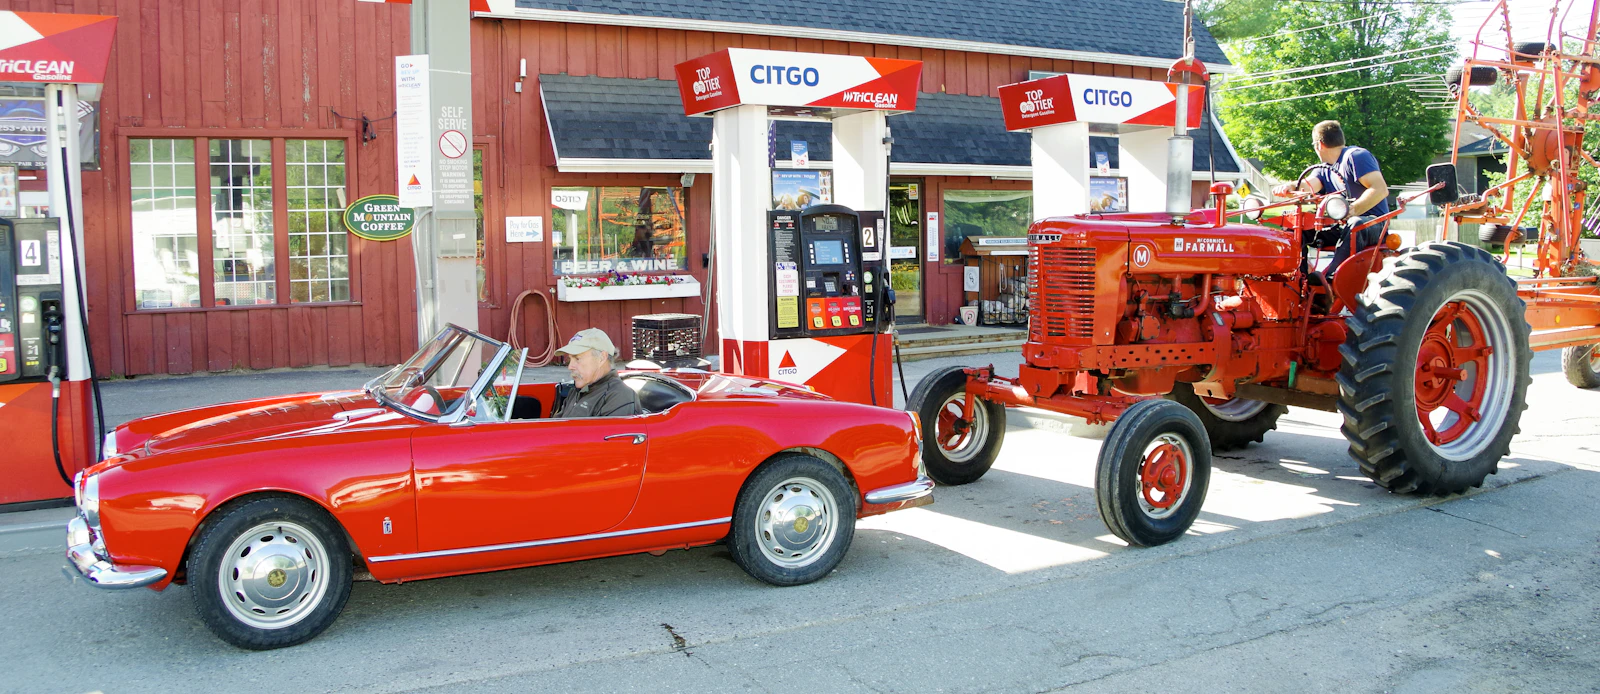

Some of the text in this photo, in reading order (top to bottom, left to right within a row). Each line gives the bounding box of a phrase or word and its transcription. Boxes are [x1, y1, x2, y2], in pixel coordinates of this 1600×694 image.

[696, 67, 711, 81] TOP
[750, 64, 819, 87] CITGO
[704, 78, 721, 92] TIER
[852, 92, 898, 104] TriCLEAN
[1025, 89, 1043, 102] TOP
[1083, 88, 1133, 108] CITGO
[1034, 98, 1054, 111] TIER
[441, 106, 464, 118] SELF
[438, 118, 467, 130] SERVE
[363, 203, 400, 213] GREEN
[353, 212, 411, 222] MOUNTAIN
[360, 222, 407, 232] COFFEE
[510, 220, 519, 230] Pay
[528, 219, 539, 229] Gas
[510, 230, 524, 238] Here
[865, 228, 873, 246] 2
[26, 242, 37, 264] 4
[1186, 242, 1234, 253] FARMALL
[1137, 250, 1147, 263] M
[560, 259, 678, 272] BEER & WINE
